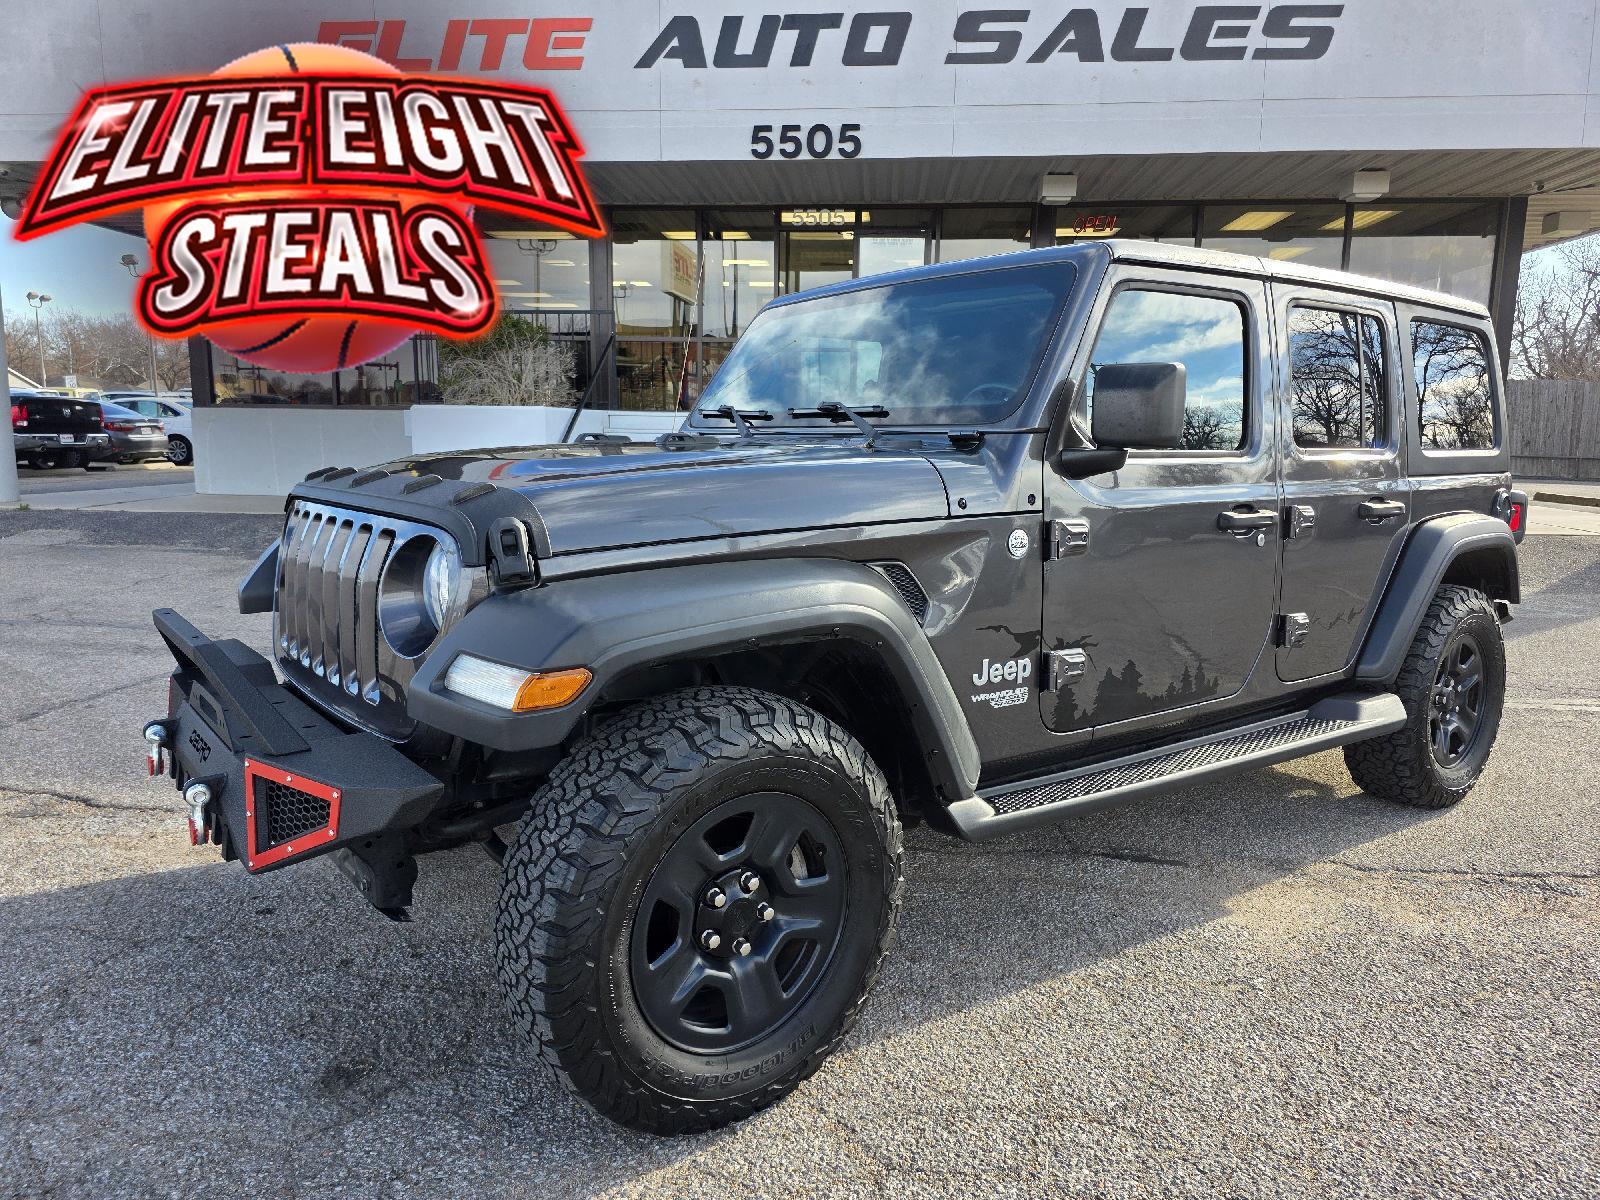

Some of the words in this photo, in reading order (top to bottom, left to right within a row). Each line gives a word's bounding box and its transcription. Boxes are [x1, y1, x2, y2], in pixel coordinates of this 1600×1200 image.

[633, 12, 913, 69] AUTO
[944, 4, 1345, 64] SALES
[751, 123, 862, 159] 5505
[791, 208, 845, 226] 5505
[1072, 215, 1117, 233] OPEN
[972, 657, 1032, 687] Jeep
